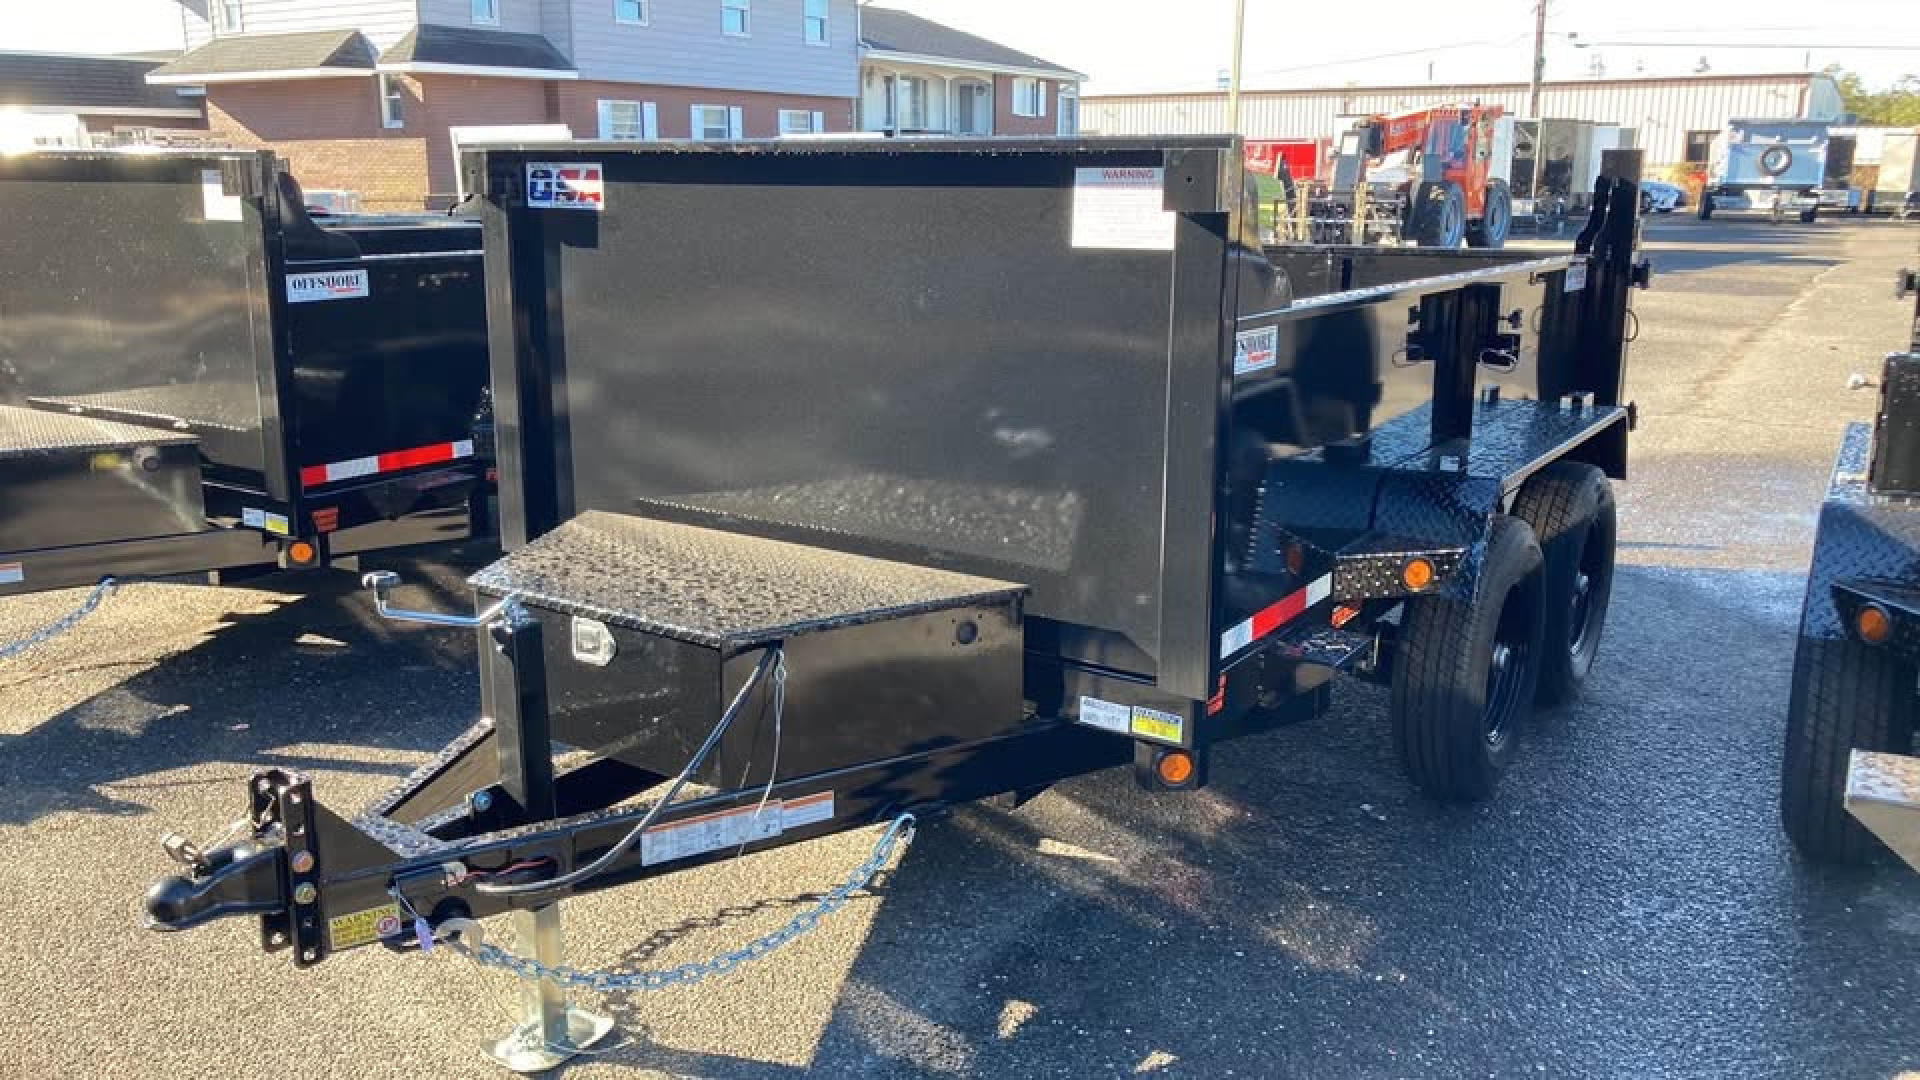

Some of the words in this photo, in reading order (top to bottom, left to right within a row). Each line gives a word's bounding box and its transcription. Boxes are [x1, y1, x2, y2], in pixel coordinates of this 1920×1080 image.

[1102, 169, 1154, 179] WARNING
[529, 168, 602, 203] USA
[290, 274, 362, 290] OFFSHORE
[332, 906, 398, 928] WARNING
